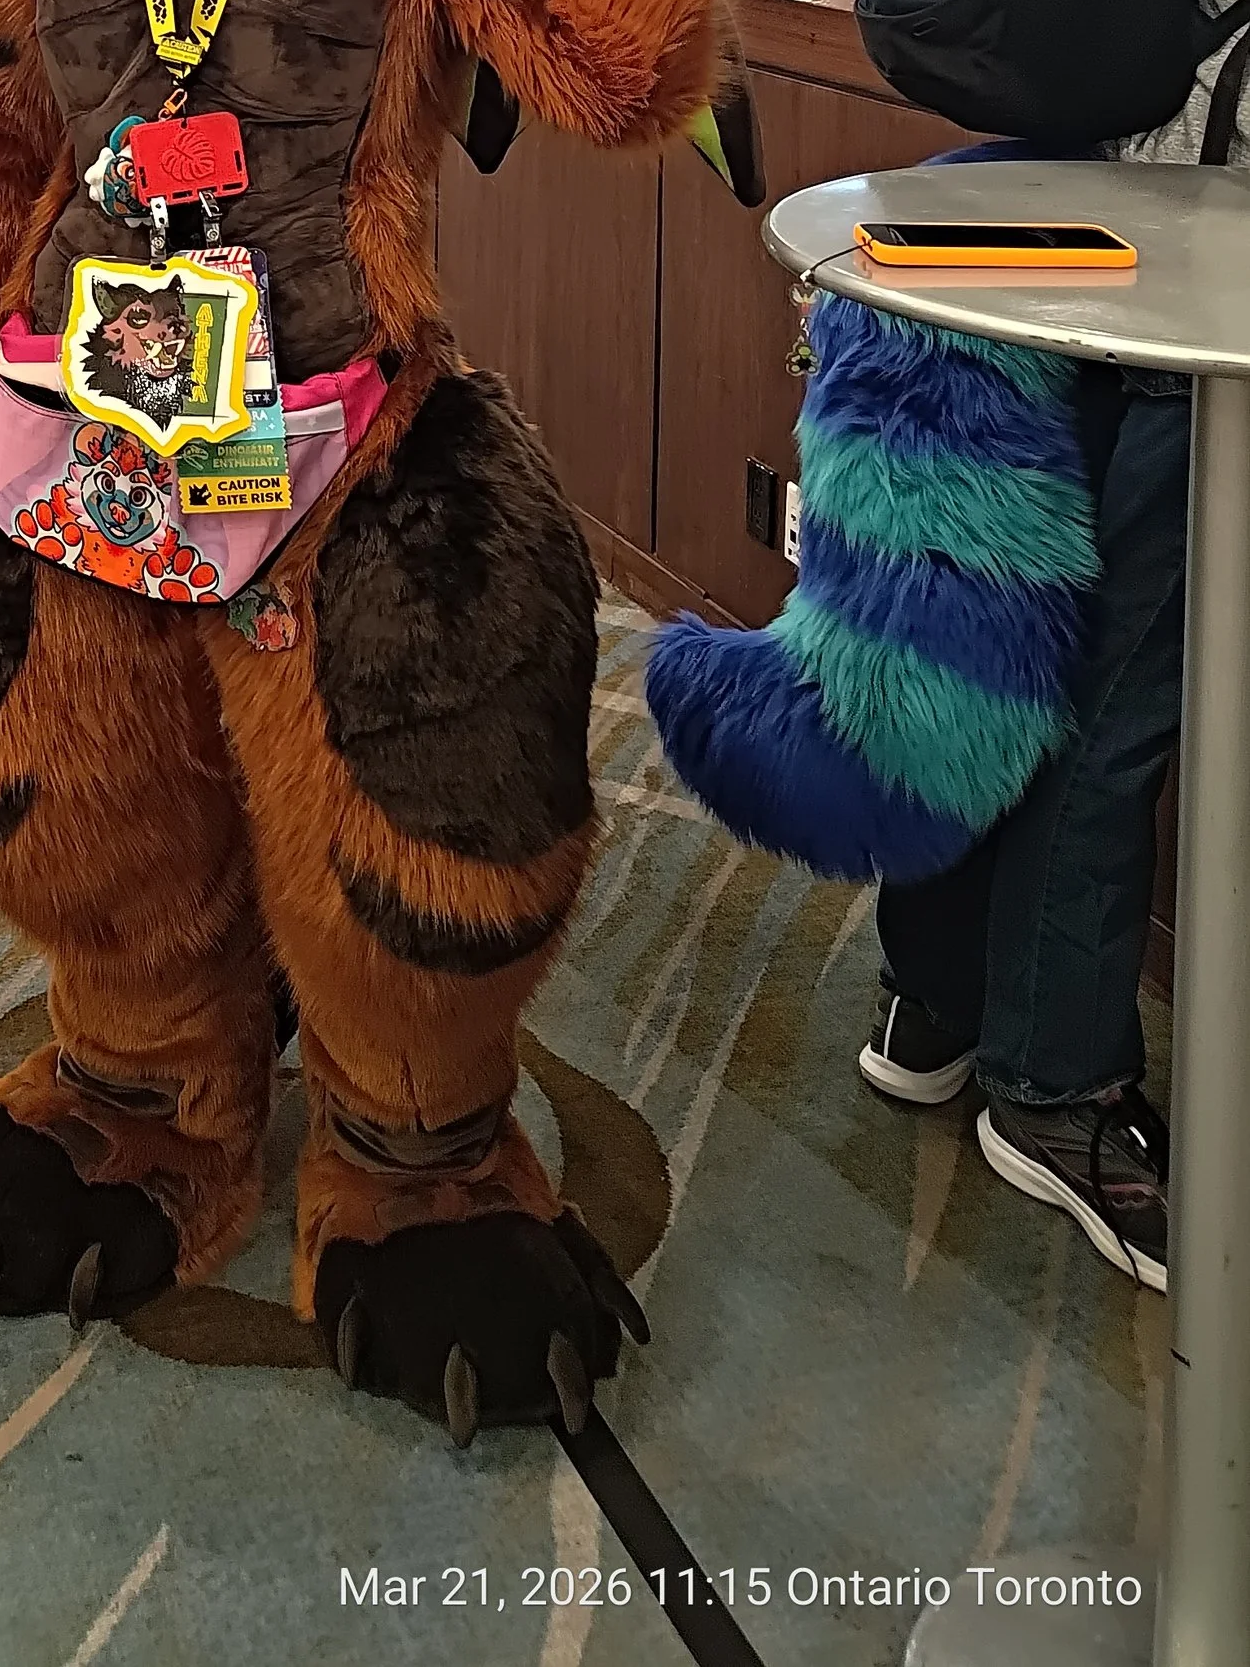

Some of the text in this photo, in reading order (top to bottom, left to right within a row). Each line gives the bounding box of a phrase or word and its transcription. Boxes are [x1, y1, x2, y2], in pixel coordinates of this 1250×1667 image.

[217, 478, 281, 491] CAUTION
[216, 492, 284, 506] BITE RISK
